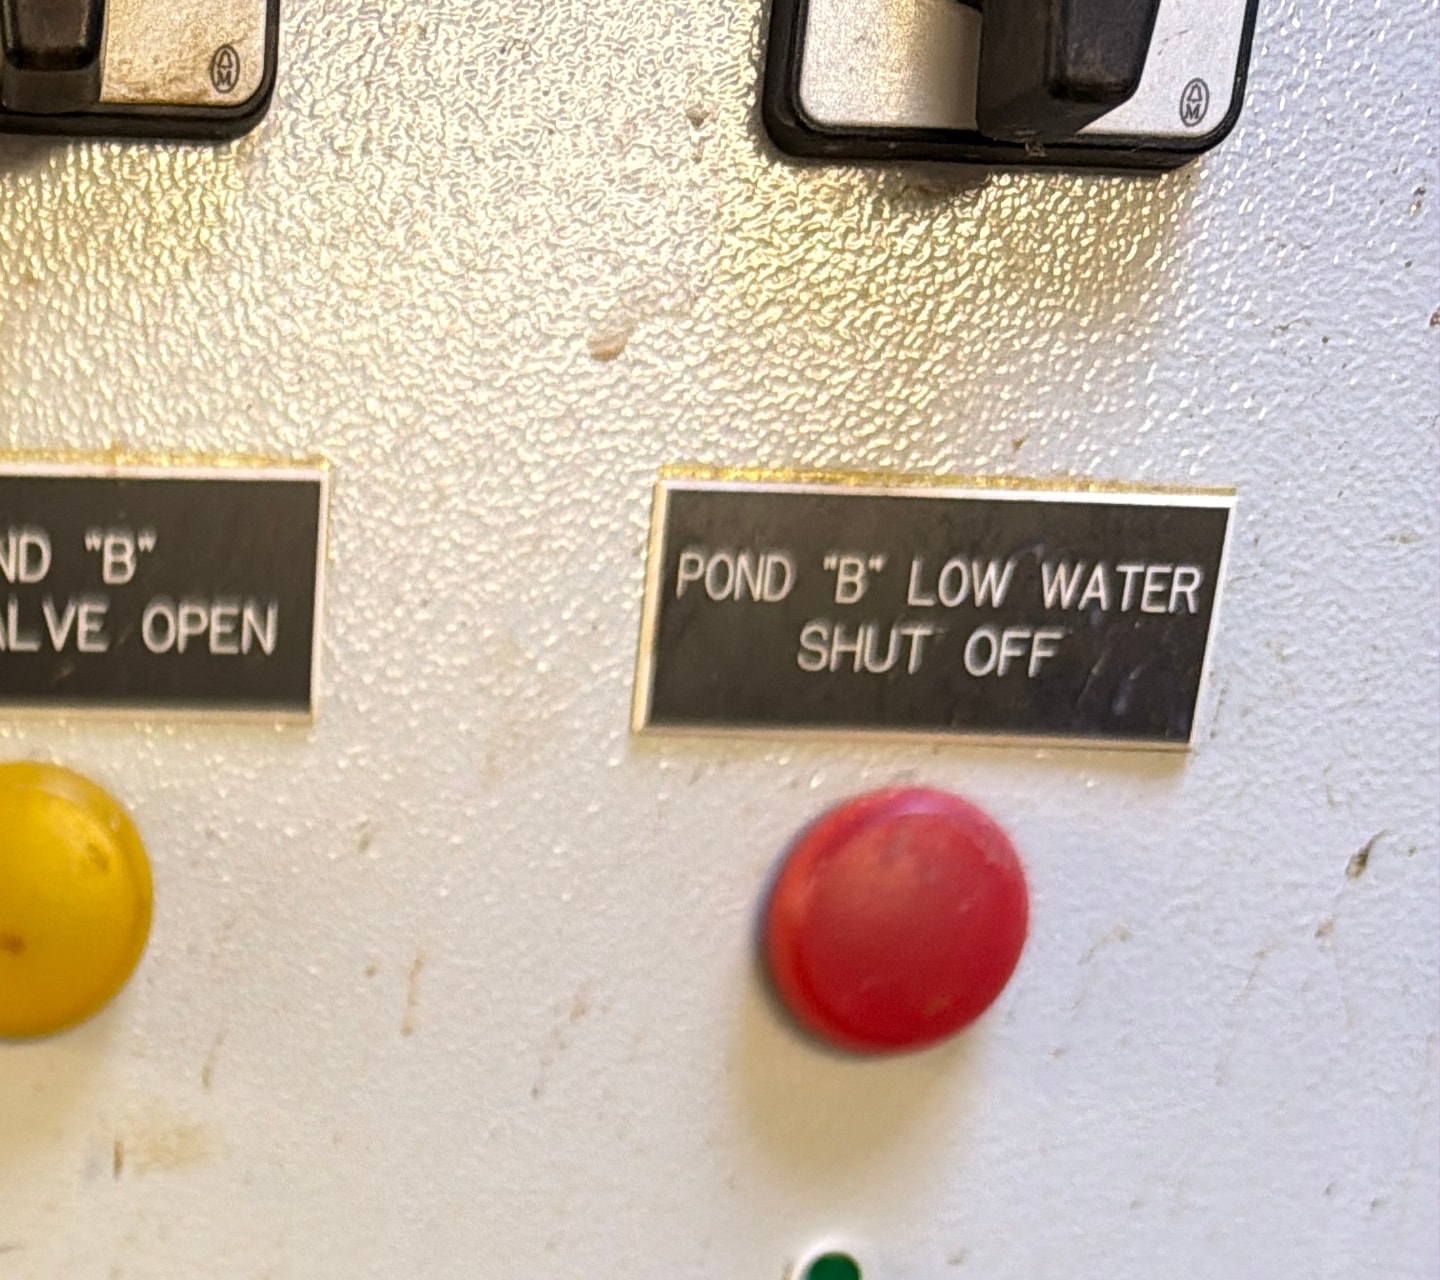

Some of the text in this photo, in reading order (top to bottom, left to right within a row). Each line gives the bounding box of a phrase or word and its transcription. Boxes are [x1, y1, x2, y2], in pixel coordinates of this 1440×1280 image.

[85, 528, 158, 585] "B"
[675, 549, 1203, 614] POND "B" LOW WATER
[141, 595, 279, 656] OPEN
[796, 619, 1064, 679] SHUT OFF
